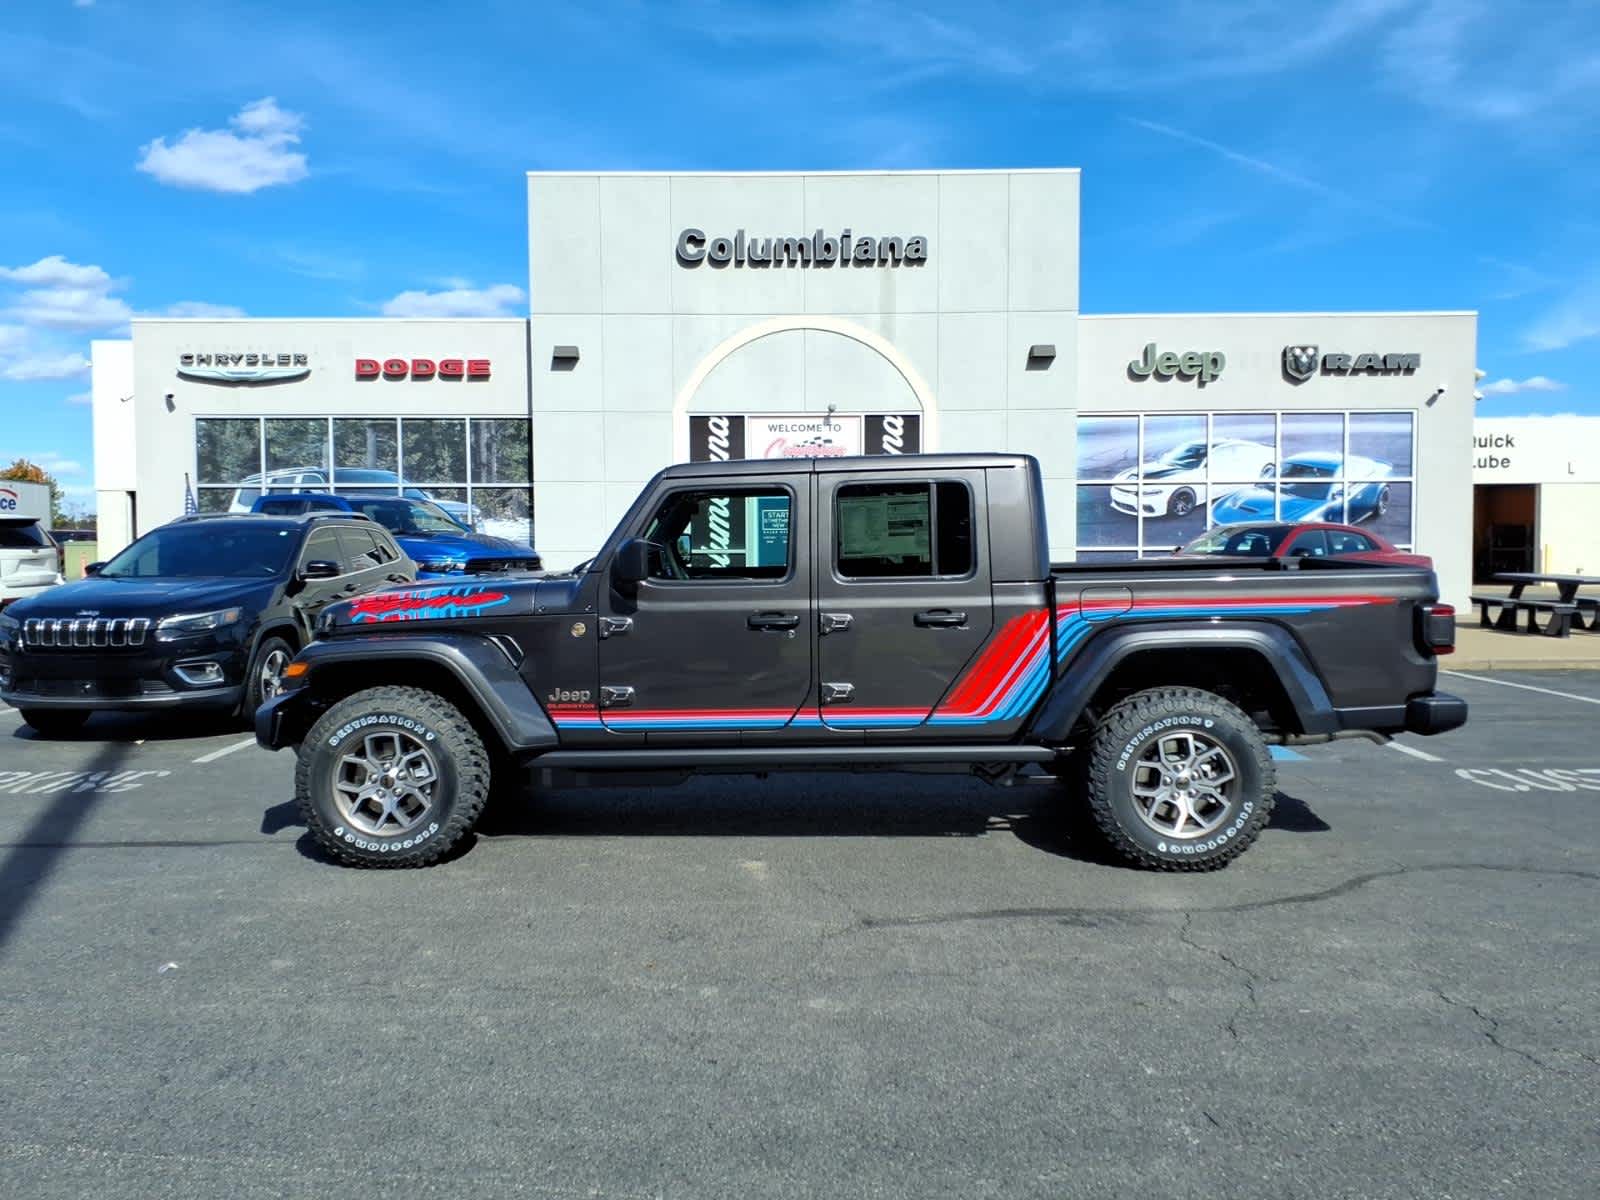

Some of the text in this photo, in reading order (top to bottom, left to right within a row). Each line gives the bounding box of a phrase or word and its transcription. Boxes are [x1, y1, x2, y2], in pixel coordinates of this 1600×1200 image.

[677, 228, 928, 266] Columbiana
[180, 353, 308, 366] CHRYSLER
[355, 359, 491, 378] DODGE
[1129, 343, 1226, 384] Jeep
[1322, 352, 1421, 373] RAM
[767, 424, 842, 433] WELCOME TO
[1472, 455, 1511, 469] ube
[548, 687, 591, 703] Jeep
[329, 715, 425, 746] DESTINATION
[1117, 716, 1202, 770] DESTINATION
